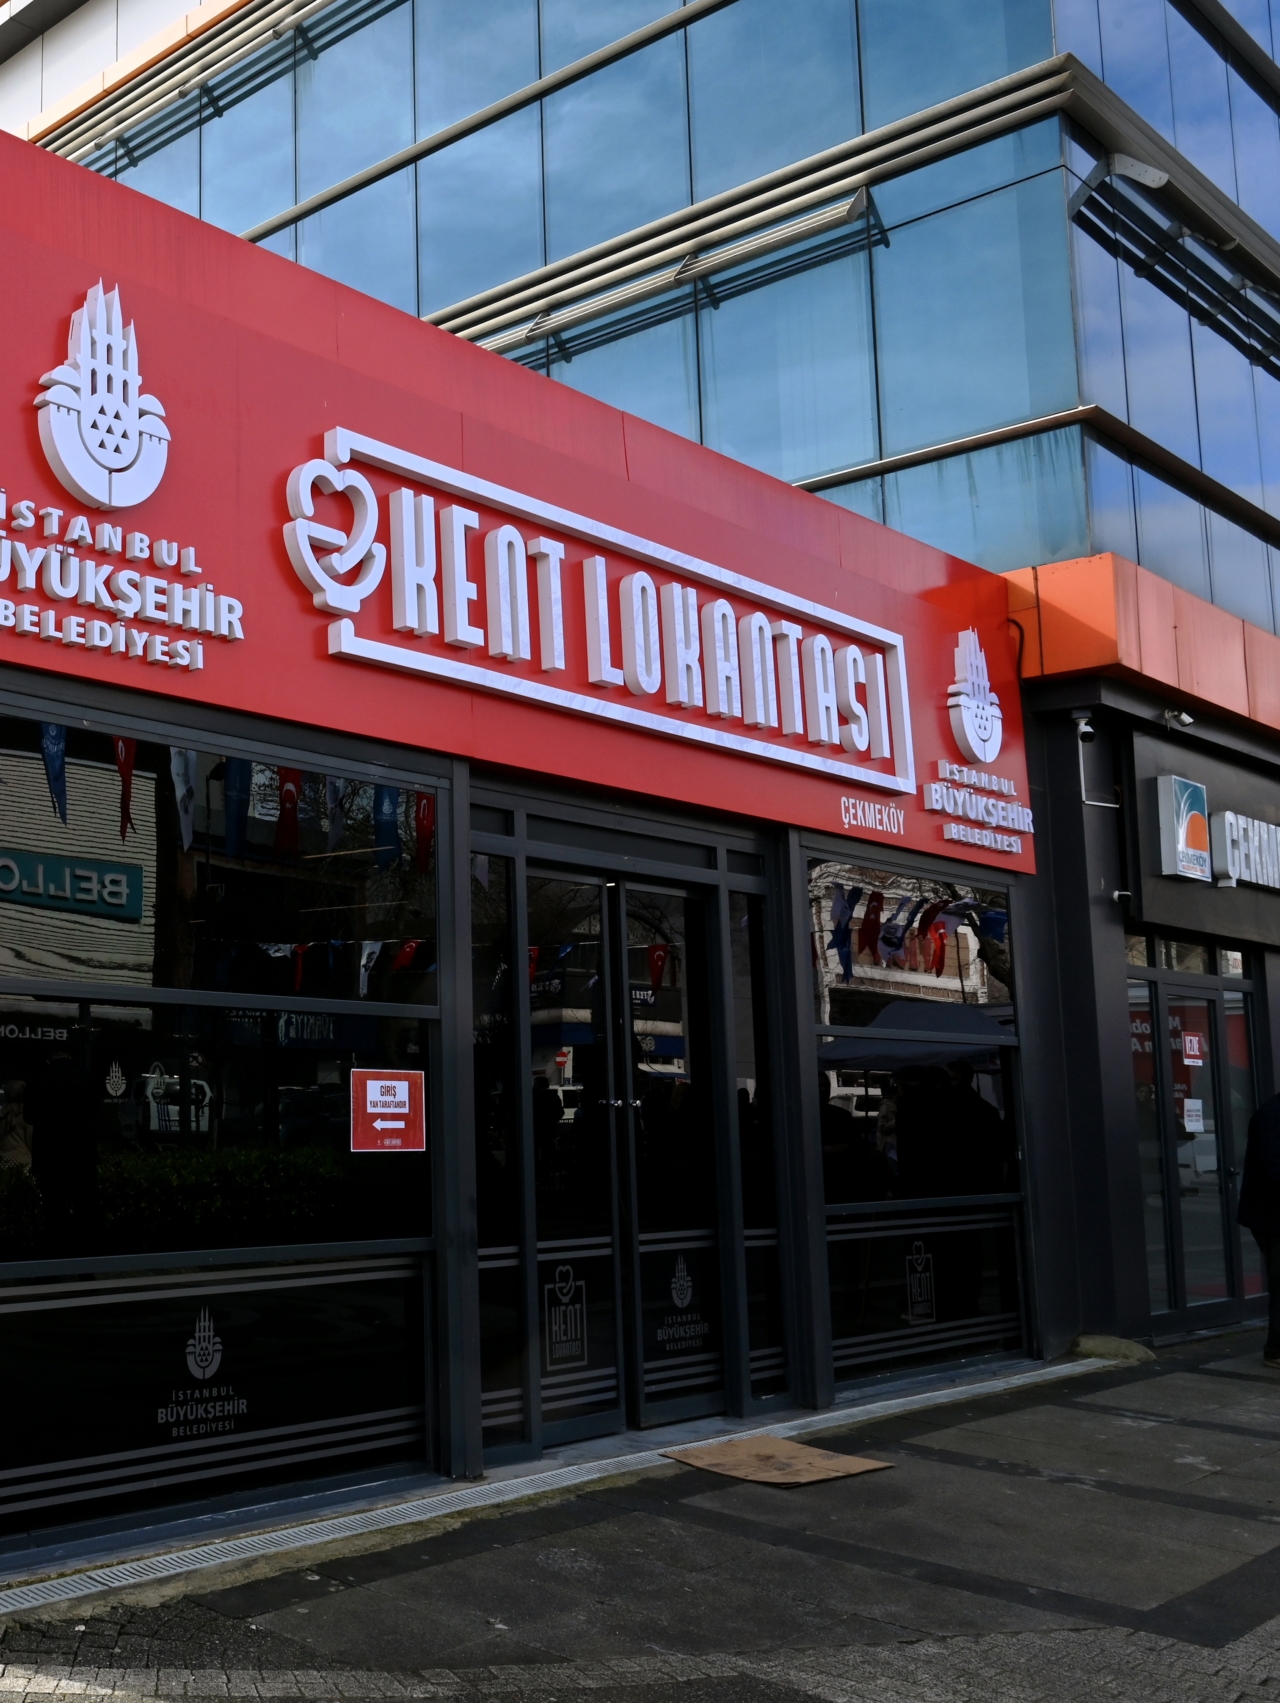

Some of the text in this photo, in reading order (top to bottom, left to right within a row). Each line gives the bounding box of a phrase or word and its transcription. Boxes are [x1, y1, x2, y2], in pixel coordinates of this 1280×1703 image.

[390, 487, 891, 759] KENT LOKANTASI
[938, 760, 1017, 796] İSTANBUL
[841, 796, 904, 835] ÇEKMEKÖY
[923, 781, 1034, 833] BÜYÜKŞEHİR
[943, 823, 1022, 854] BELEDİYESİ
[1213, 811, 1280, 888] ÇEKM
[379, 1100, 407, 1109] TARAFTANDIR
[380, 1084, 397, 1099] GİRİŞ
[552, 1303, 581, 1342] KENT
[657, 1322, 710, 1341] BÜYÜKŞEHİR
[664, 1313, 701, 1324] İSTANBUL
[665, 1338, 703, 1350] BELEDİYESİ
[172, 1386, 234, 1401] İSTANBUL
[158, 1397, 248, 1423] BÜYÜKŞEHİR
[172, 1418, 235, 1437] BELEDİYESİ
